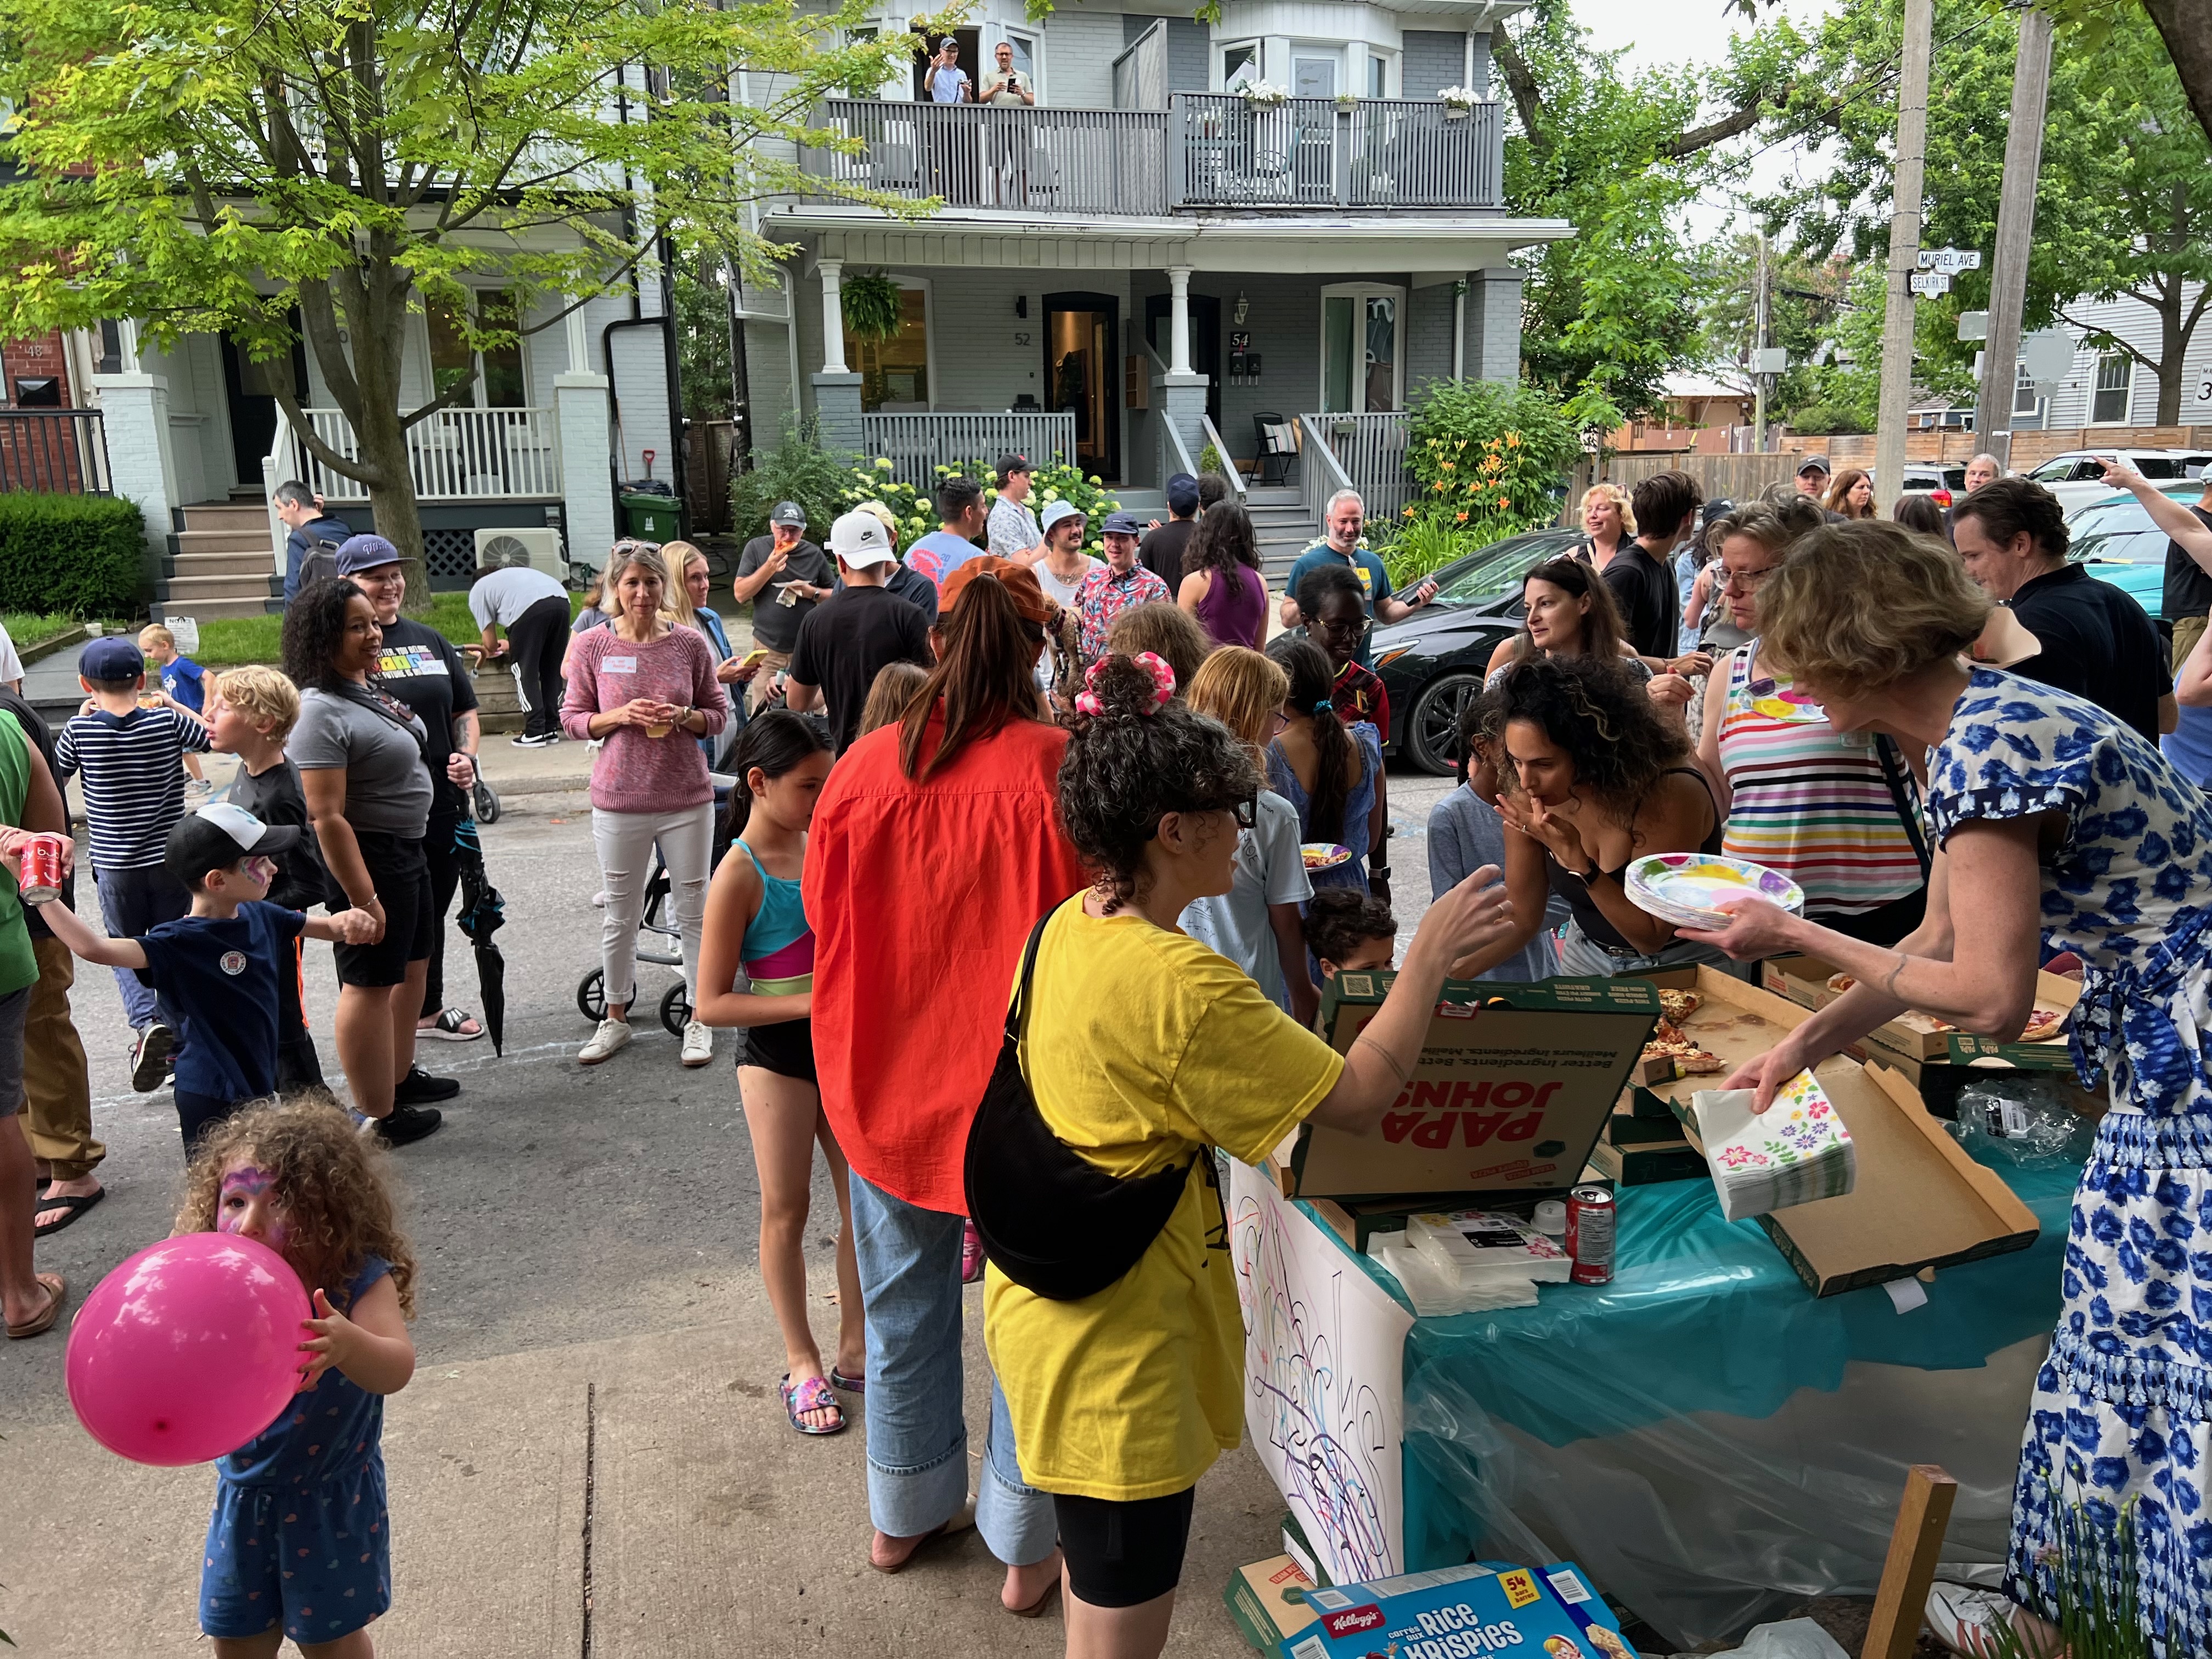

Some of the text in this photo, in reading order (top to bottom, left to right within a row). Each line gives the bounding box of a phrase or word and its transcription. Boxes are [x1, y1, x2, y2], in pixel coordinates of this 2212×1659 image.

[1920, 253, 1954, 266] MURIEL
[1912, 276, 1939, 289] SELKIRK
[1015, 332, 1030, 346] 52
[1232, 334, 1249, 346] 54
[24, 345, 43, 357] 48
[1561, 1060, 1613, 1069] Better
[1381, 1111, 1544, 1149] PAPA
[1505, 1576, 1527, 1592] 54
[1514, 1589, 1528, 1597] bars
[1514, 1592, 1535, 1603] barres
[1333, 1612, 1377, 1630] Kellogg's
[1387, 1626, 1421, 1640] carrés
[1406, 1632, 1425, 1642] aux
